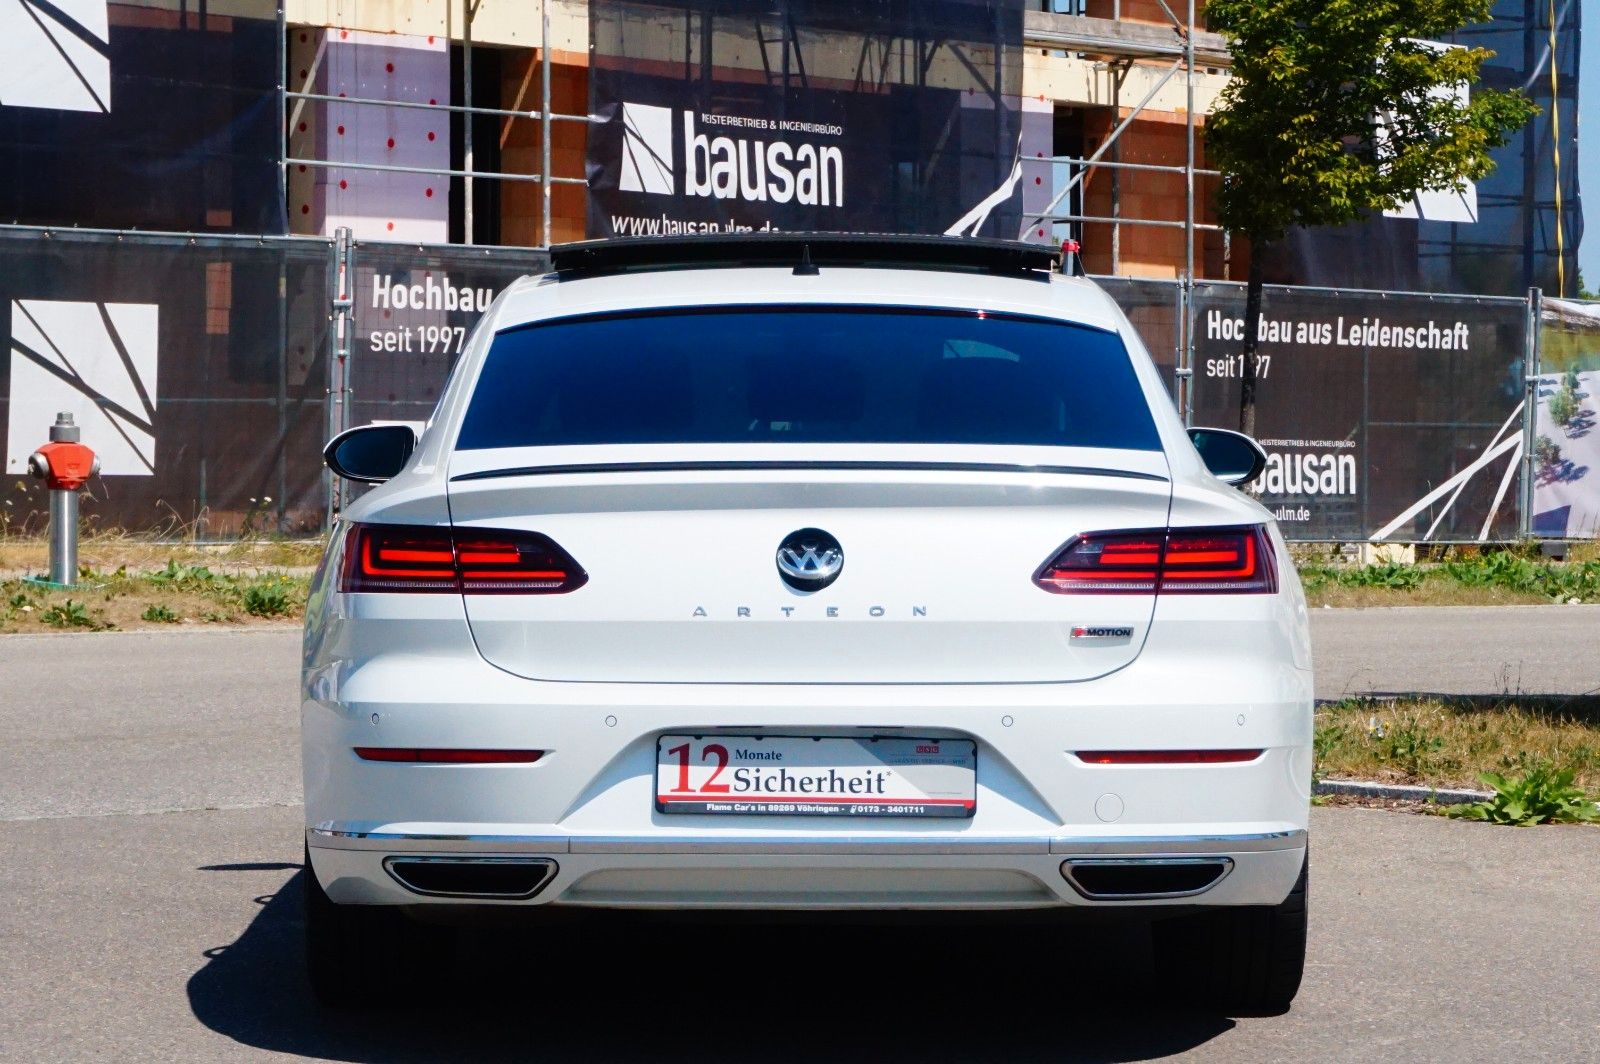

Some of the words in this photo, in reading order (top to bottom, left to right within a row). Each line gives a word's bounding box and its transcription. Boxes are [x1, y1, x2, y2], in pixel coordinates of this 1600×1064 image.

[769, 120, 777, 130] &
[683, 110, 843, 207] bausan
[372, 274, 493, 313] Hochbau
[370, 325, 413, 353] seit
[417, 325, 466, 354] 1997
[1207, 310, 1292, 343] Hocbau
[1296, 324, 1333, 345] aus
[1336, 316, 1469, 350] Leidenschaft
[1206, 354, 1236, 378] seit
[1237, 354, 1271, 379] 197
[1309, 439, 1356, 448] INGENIEURBÜRO
[693, 606, 926, 618] ARTEON
[668, 742, 730, 793] 12
[735, 749, 782, 761] Monate
[706, 803, 732, 811] Flame
[734, 803, 756, 812] Car's
[797, 803, 840, 814] Vöhringen
[857, 805, 880, 813] 0173
[887, 805, 925, 814] 3401711
